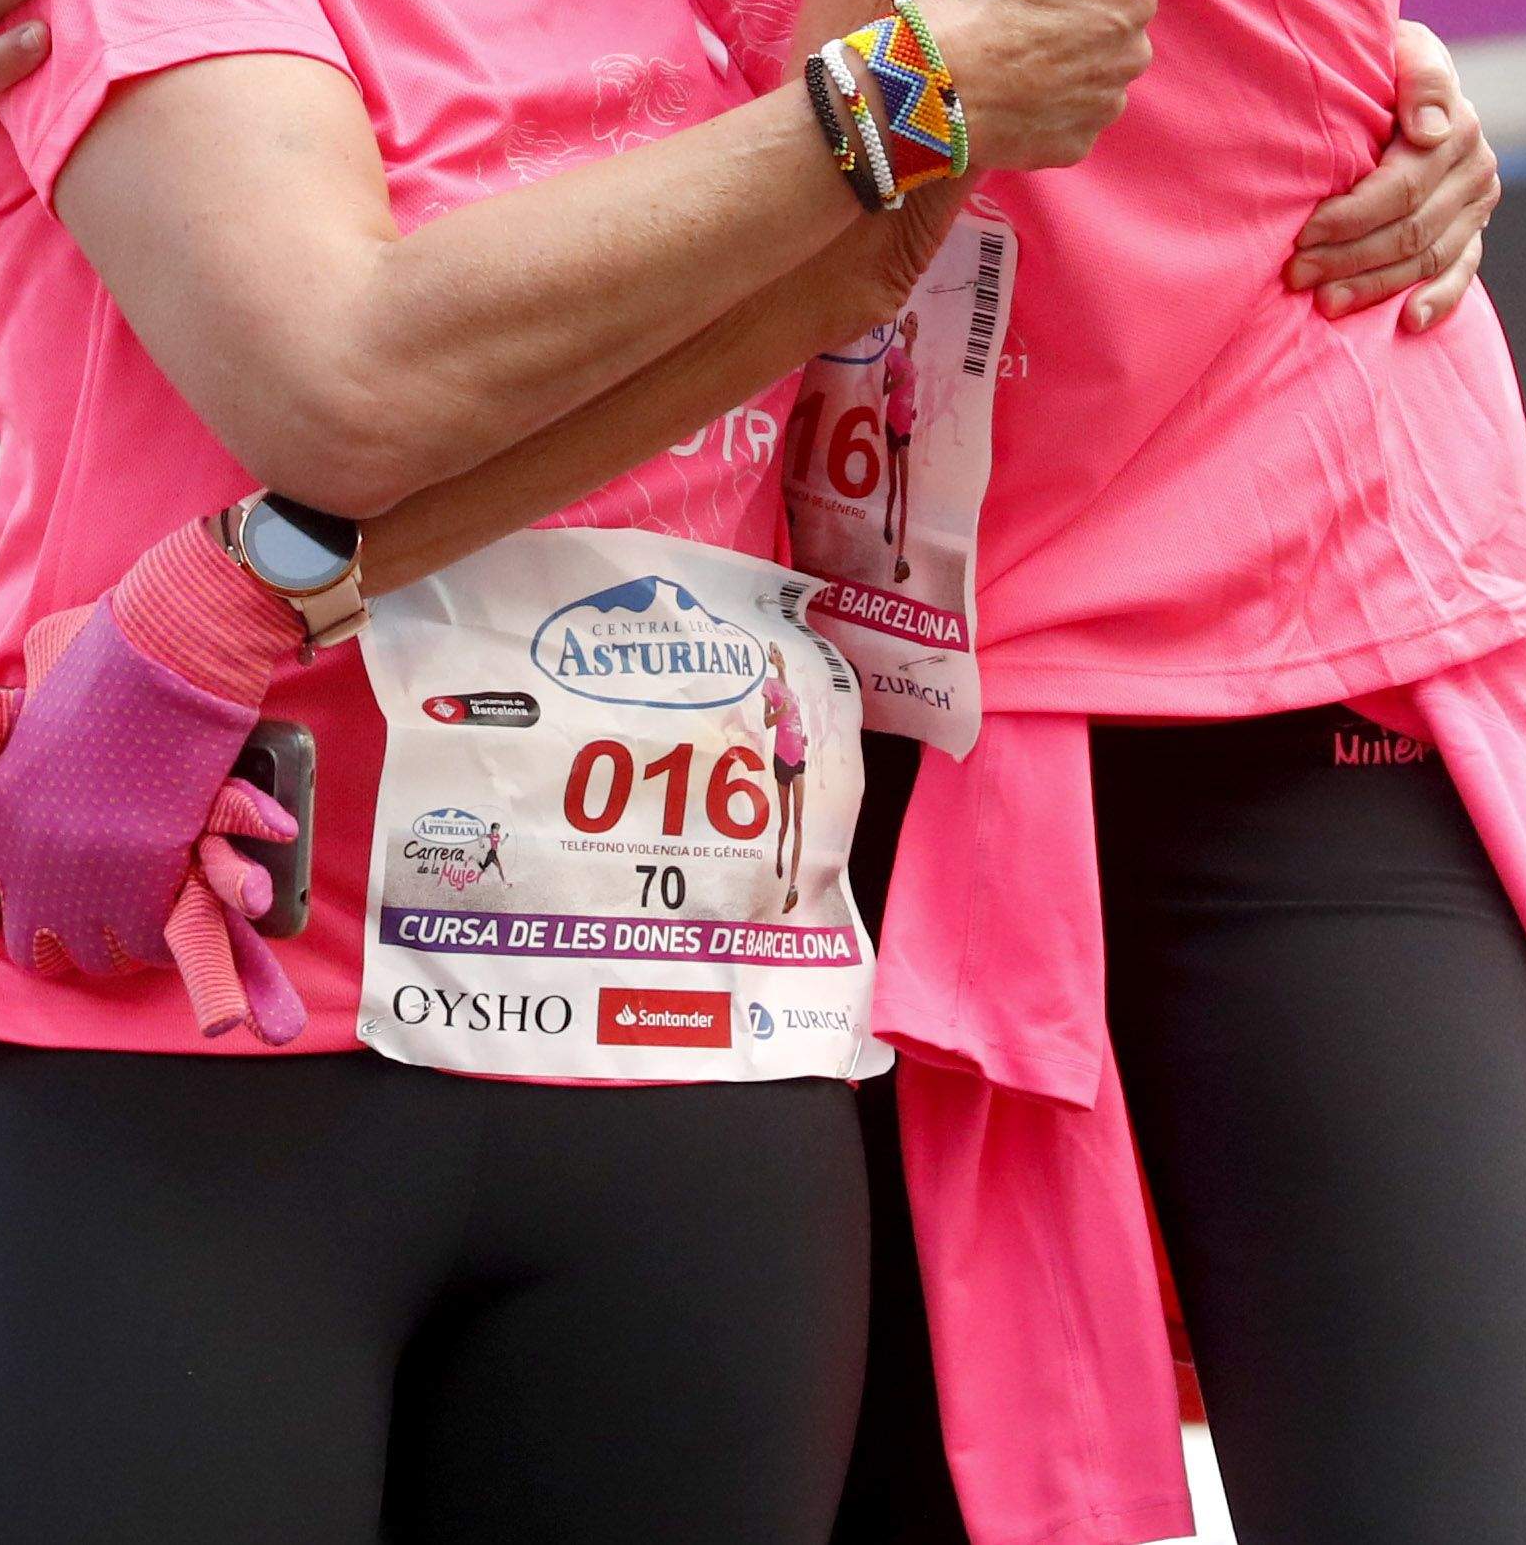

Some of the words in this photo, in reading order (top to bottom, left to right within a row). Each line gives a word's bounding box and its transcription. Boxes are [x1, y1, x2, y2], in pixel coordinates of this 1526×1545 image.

[592, 620, 682, 636] CENTRAL
[838, 586, 962, 644] BARCELONA
[555, 627, 755, 677] ASTURIANA
[471, 705, 529, 716] Barcelona
[872, 673, 952, 711] ZURICH
[563, 739, 770, 841] 016
[418, 820, 480, 837] ASTURIANA
[403, 840, 465, 861] Carrera
[560, 839, 625, 854] TELÉFONO
[627, 843, 690, 857] VIOLENCIA
[693, 846, 710, 858] DE
[714, 846, 763, 860] GÉNERO
[417, 863, 428, 875] de
[430, 862, 439, 875] la
[437, 862, 484, 891] Mujer
[635, 864, 686, 910] 70
[398, 914, 499, 947] CURSA
[508, 920, 547, 950] DE
[553, 921, 607, 951] LES
[613, 923, 702, 955] DONES
[392, 984, 572, 1035] OYSHO
[638, 1007, 714, 1030] Santander
[782, 1007, 849, 1032] ZURICH
